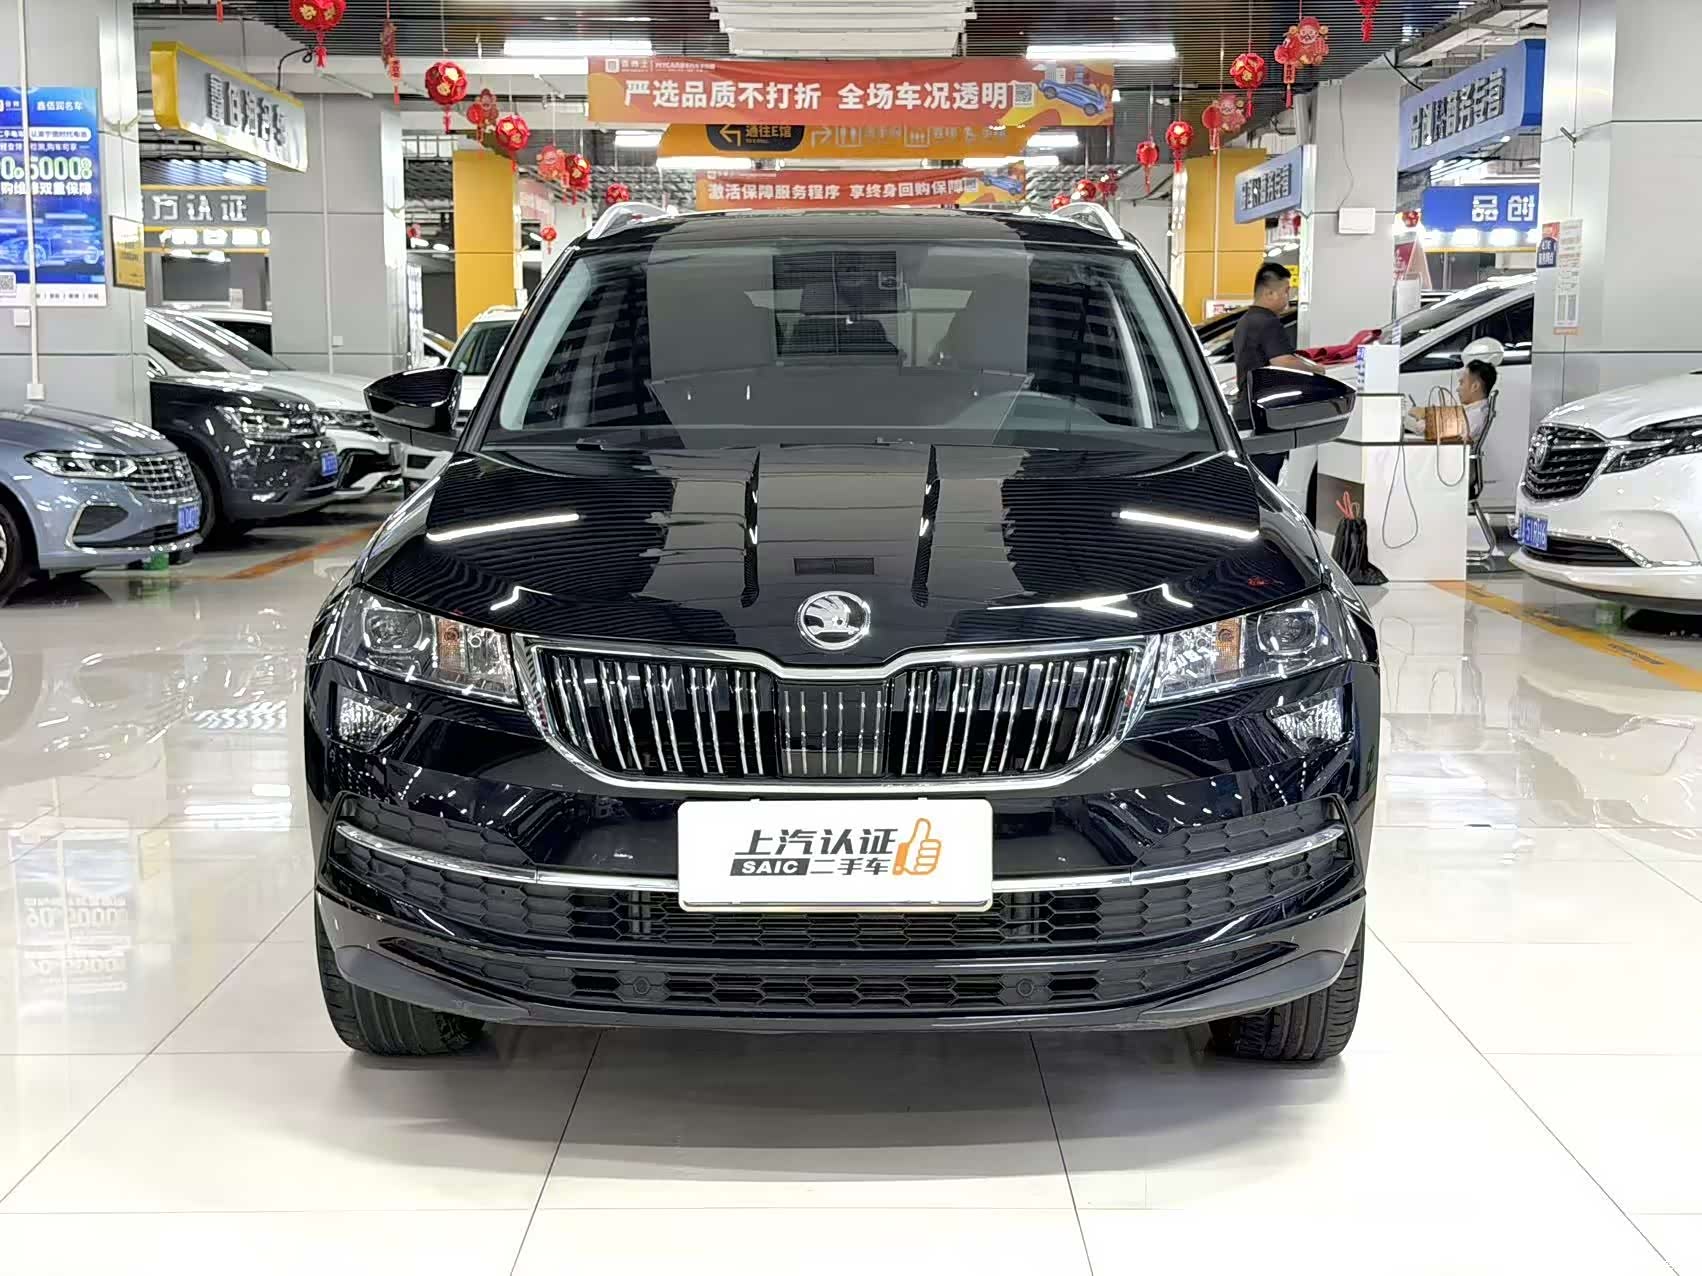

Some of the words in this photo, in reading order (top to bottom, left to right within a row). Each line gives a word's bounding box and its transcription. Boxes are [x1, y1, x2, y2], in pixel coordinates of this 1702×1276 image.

[624, 79, 821, 112] 严选品质不打折
[837, 79, 1009, 111] 全场车况透明
[707, 180, 840, 201] 激活保障服务程序
[849, 178, 963, 200] 享终身回购保障
[151, 193, 248, 222] 方认证
[1471, 194, 1536, 222] 品创
[734, 828, 899, 855] 上汽认证
[741, 861, 800, 874] SAIC
[810, 858, 892, 876] 二手车
